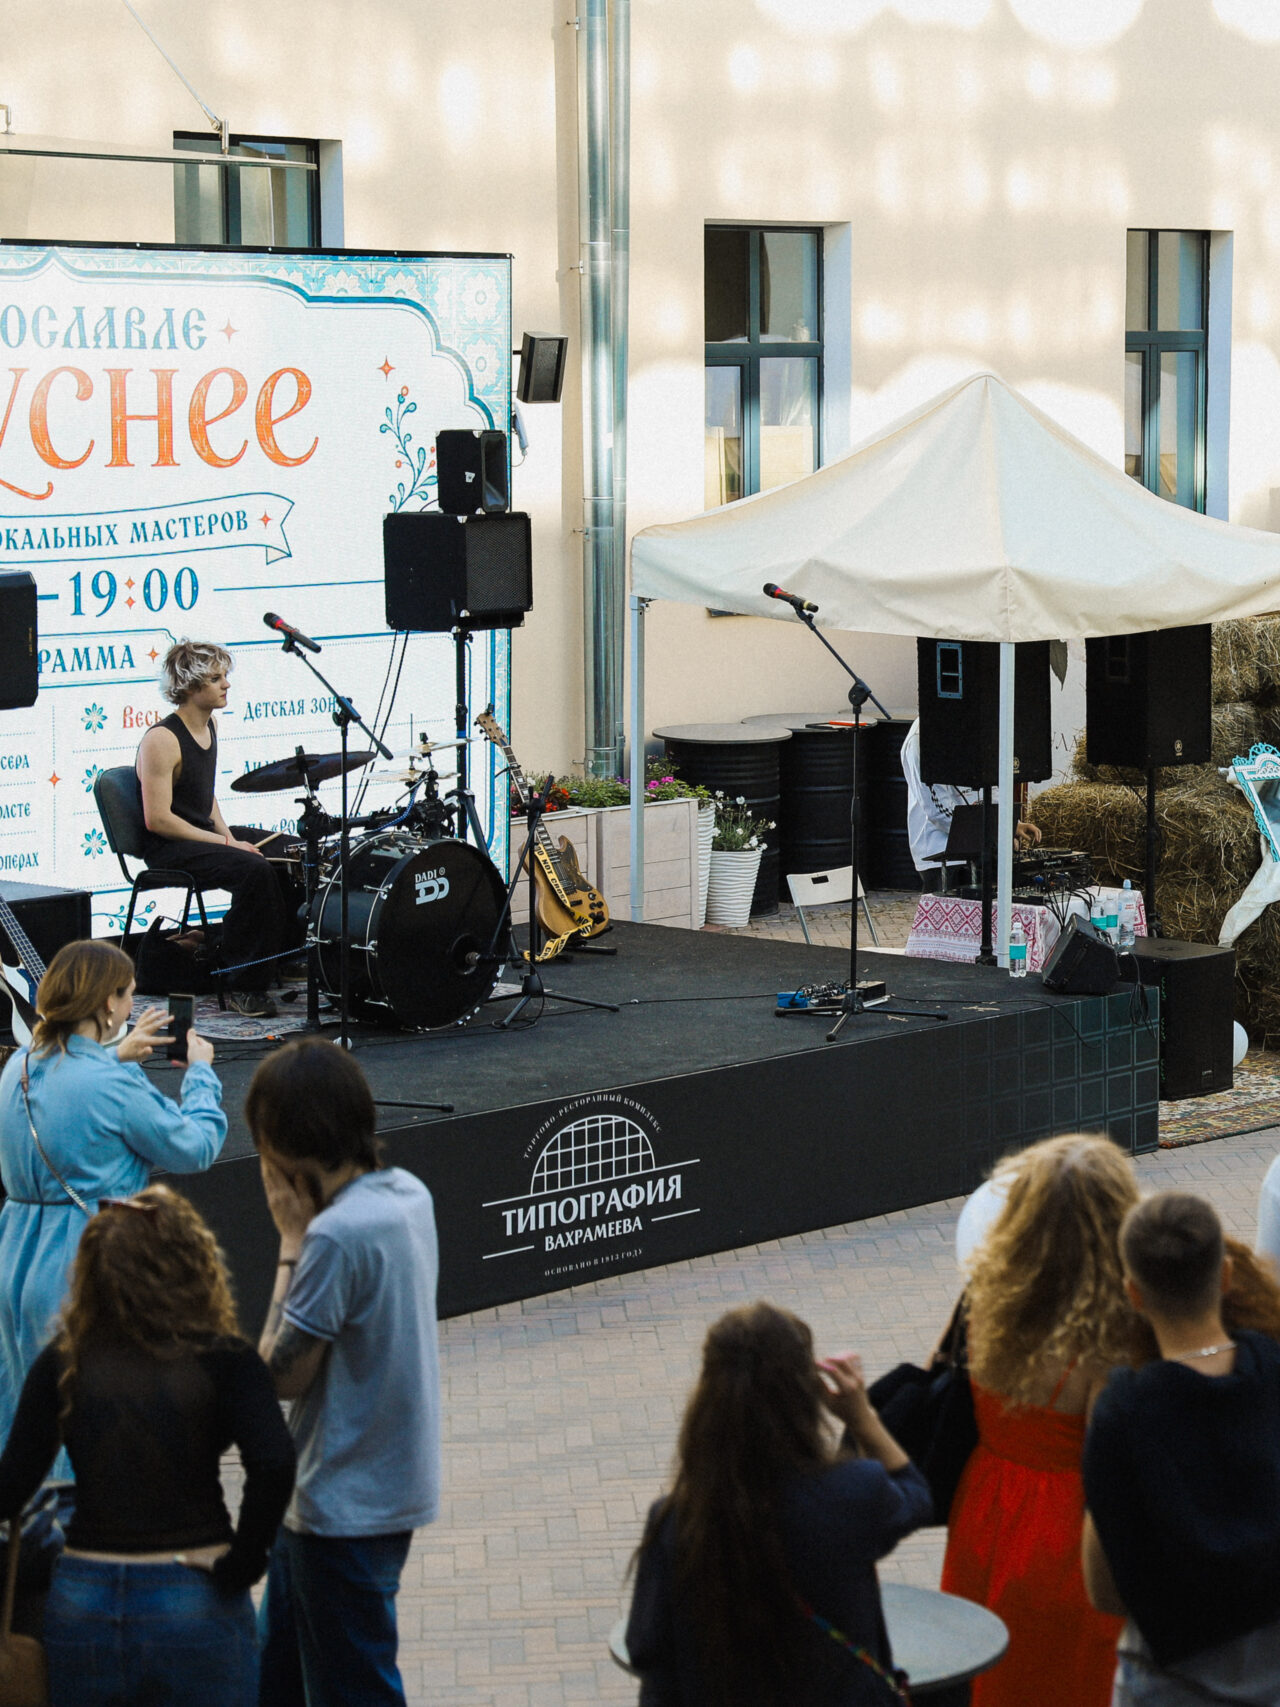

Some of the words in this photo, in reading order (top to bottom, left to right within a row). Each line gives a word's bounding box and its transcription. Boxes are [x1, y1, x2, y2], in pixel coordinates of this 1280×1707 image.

[0, 523, 119, 551] КАЛЬНЫХ
[129, 510, 249, 544] МАСТЕРОВ
[68, 566, 199, 618] 19:00
[38, 644, 136, 674] РАММА
[243, 699, 305, 724] ДЕТСКАЯ
[310, 696, 342, 715] ЗОН
[414, 869, 437, 883] DADI
[623, 1097, 663, 1134] КОМПЛЕКС
[501, 1174, 683, 1237] ТИПОГРАФИЯ
[544, 1216, 643, 1252] ВАХРАМЕЕВА
[544, 1260, 592, 1277] ОСНОВАНО
[621, 1248, 643, 1260] ГОДУ
